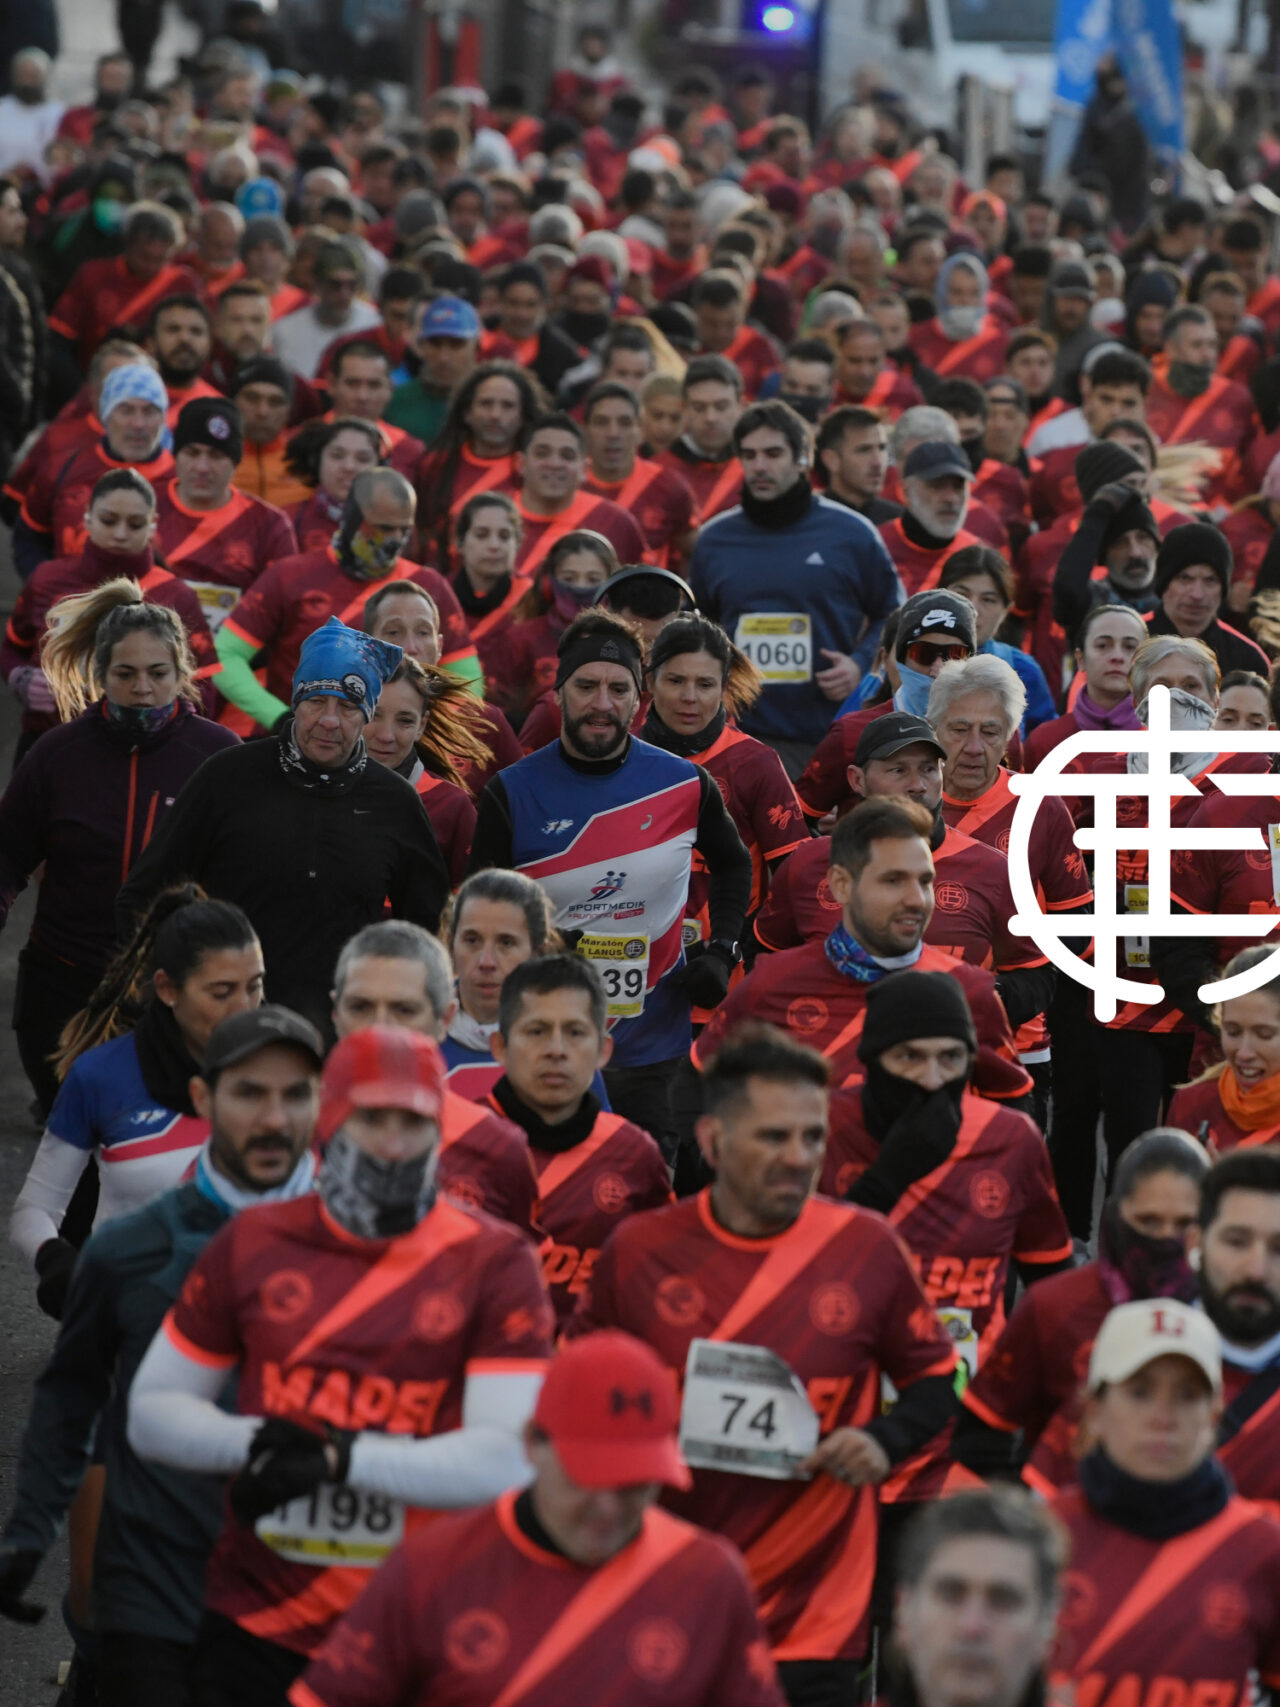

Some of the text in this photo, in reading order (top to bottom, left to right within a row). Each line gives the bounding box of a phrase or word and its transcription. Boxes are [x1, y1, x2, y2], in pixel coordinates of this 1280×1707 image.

[742, 642, 808, 666] 1060
[567, 900, 647, 912] SPORTMEDIK
[262, 1361, 449, 1437] MAPEI
[721, 1393, 776, 1439] 74
